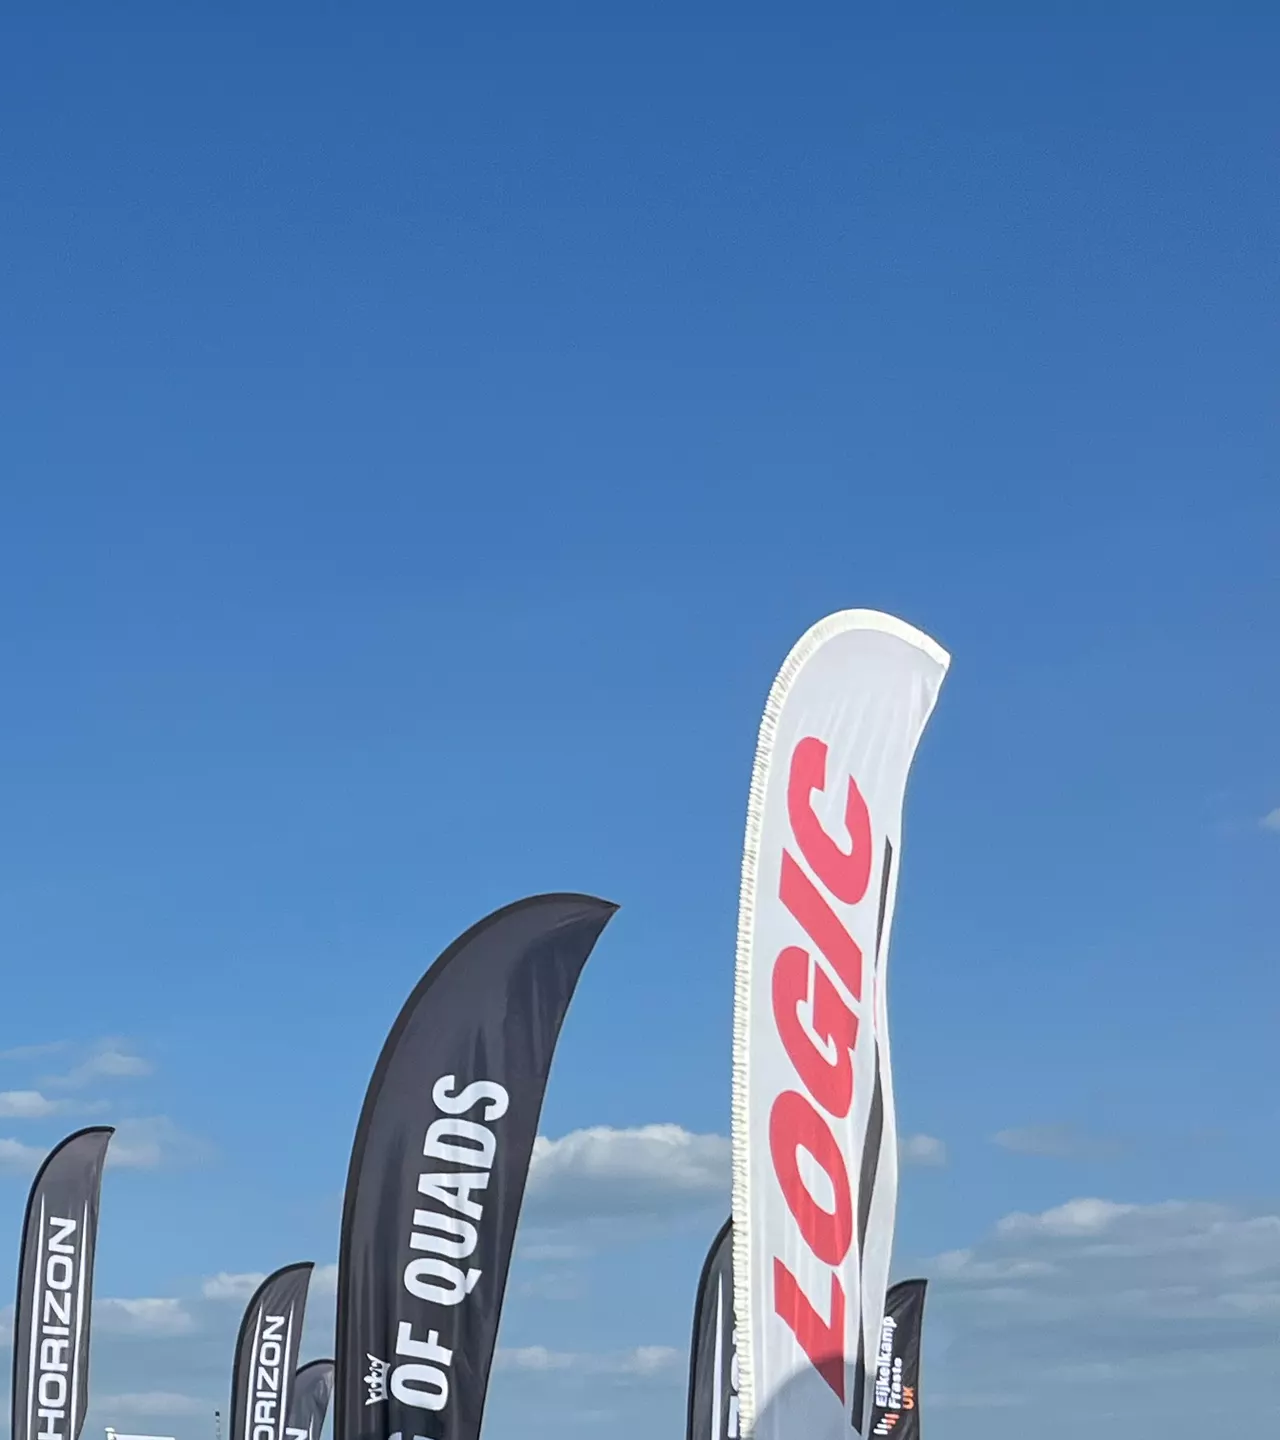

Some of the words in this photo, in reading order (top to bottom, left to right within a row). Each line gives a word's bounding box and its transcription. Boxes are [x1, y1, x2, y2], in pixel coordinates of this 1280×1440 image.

[769, 736, 873, 1407] LOGIC
[404, 1074, 509, 1306] QUADS
[390, 1321, 454, 1411] OF
[902, 1386, 915, 1410] UK
